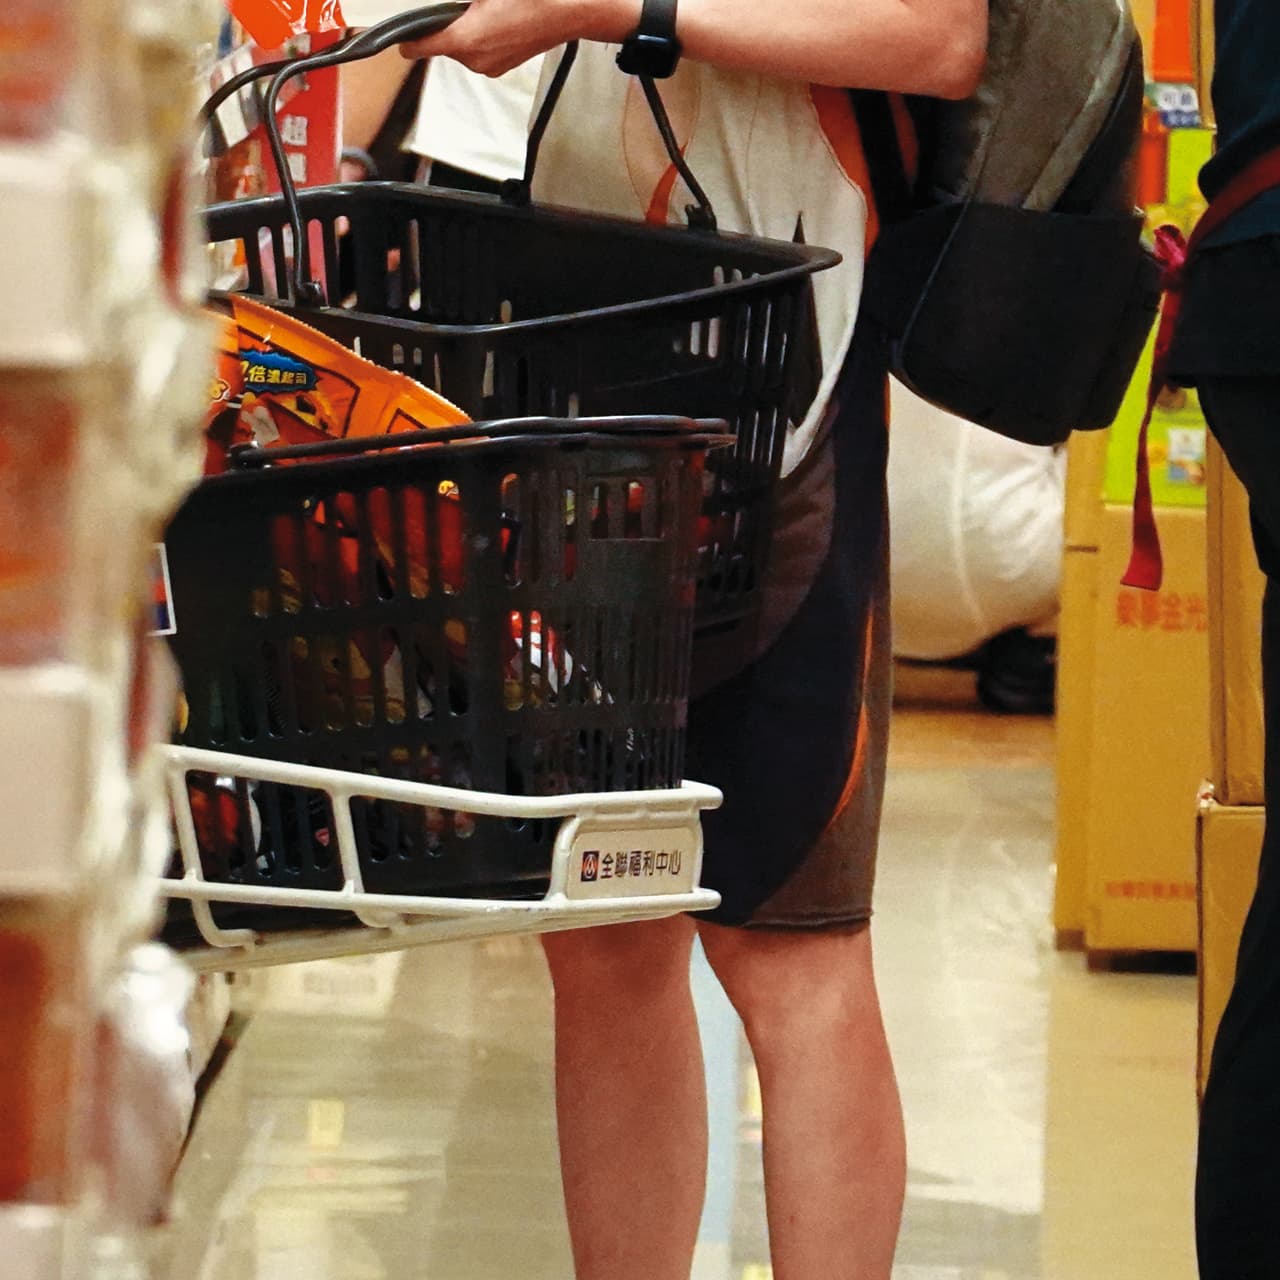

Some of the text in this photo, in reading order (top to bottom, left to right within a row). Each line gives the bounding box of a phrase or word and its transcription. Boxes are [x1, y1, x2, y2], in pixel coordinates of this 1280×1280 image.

[600, 850, 682, 880] 全聯福利中心
